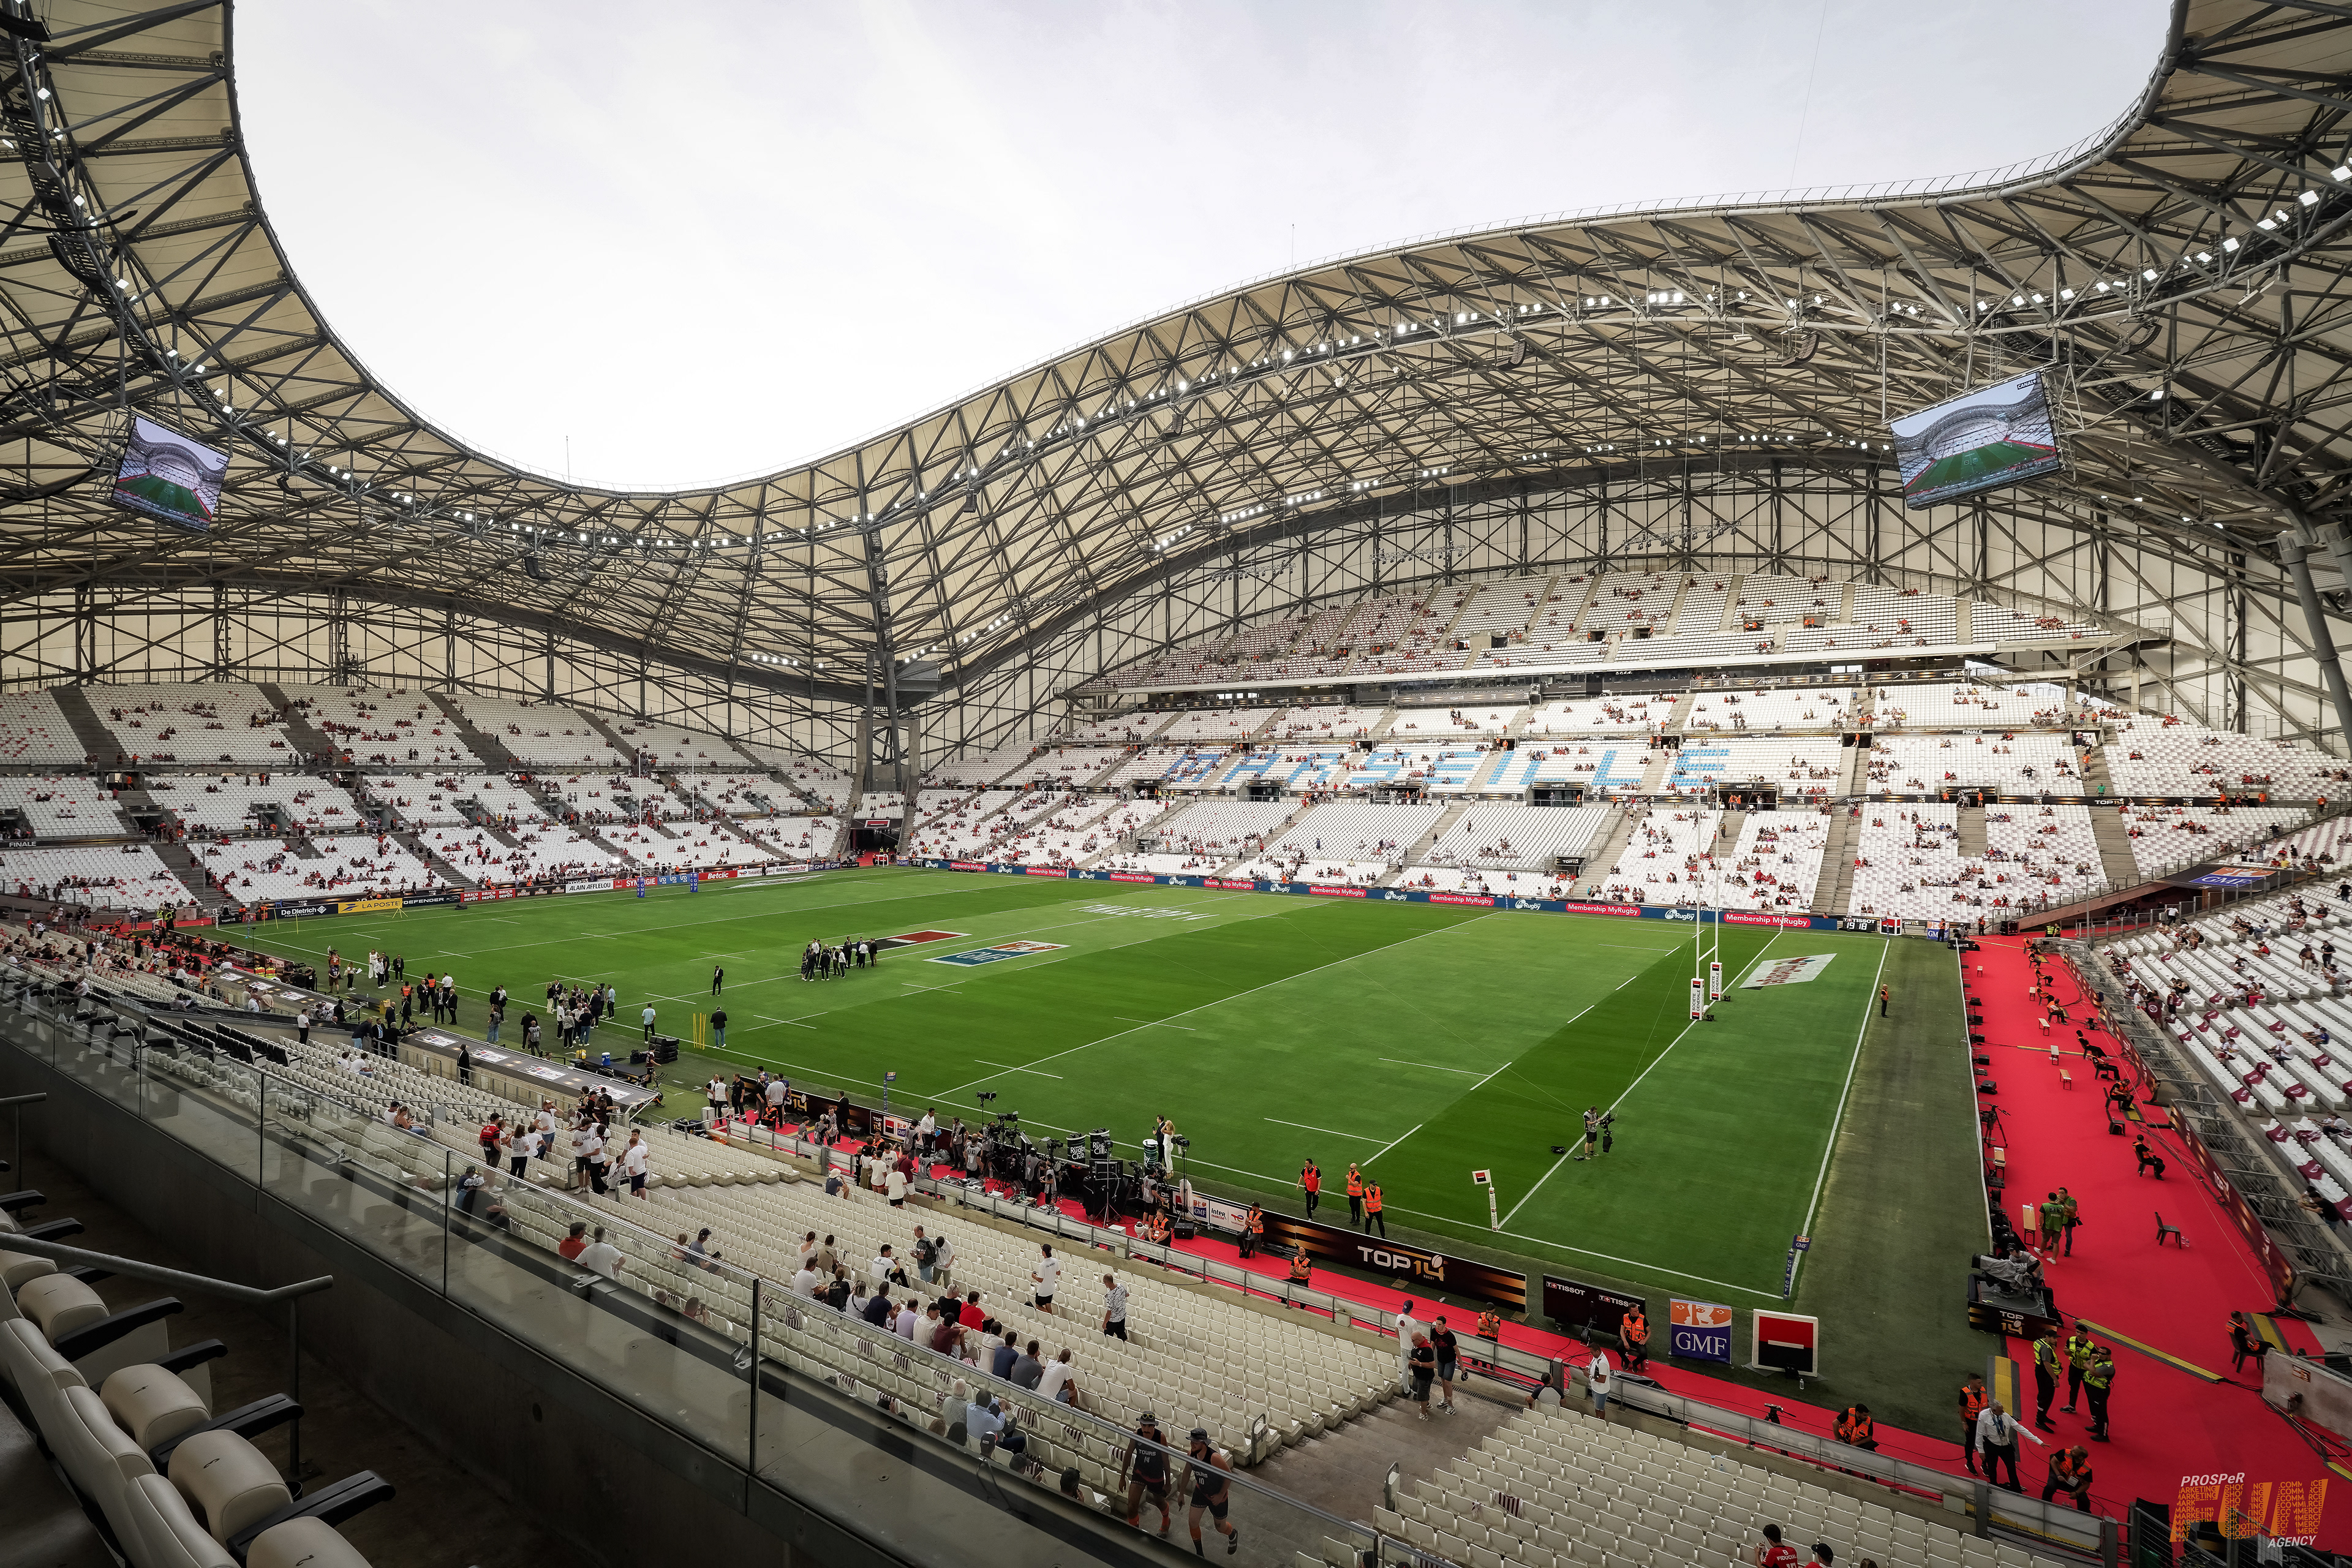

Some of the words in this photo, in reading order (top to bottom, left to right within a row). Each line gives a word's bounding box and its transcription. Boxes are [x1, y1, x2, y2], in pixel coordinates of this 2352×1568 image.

[2018, 379, 2037, 389] CANAL+
[1164, 748, 1731, 786] MARSEILLE
[626, 878, 656, 887] SYNRGIE
[1431, 895, 1464, 903] Membership
[1466, 897, 1491, 905] MyRugby
[1568, 904, 1606, 913] Membership
[1608, 907, 1638, 916] MyRugby
[1726, 914, 1771, 924] Membership
[1773, 916, 1807, 927] MyRugby
[1070, 1145, 1086, 1155] Rugby
[1357, 1245, 1444, 1282] TOP14
[1557, 1284, 1586, 1296] TISSOT
[1610, 1297, 1640, 1308] TISST
[1999, 1311, 2024, 1320] TOP
[2001, 1322, 2022, 1335] 14
[1675, 1332, 1727, 1355] GMF
